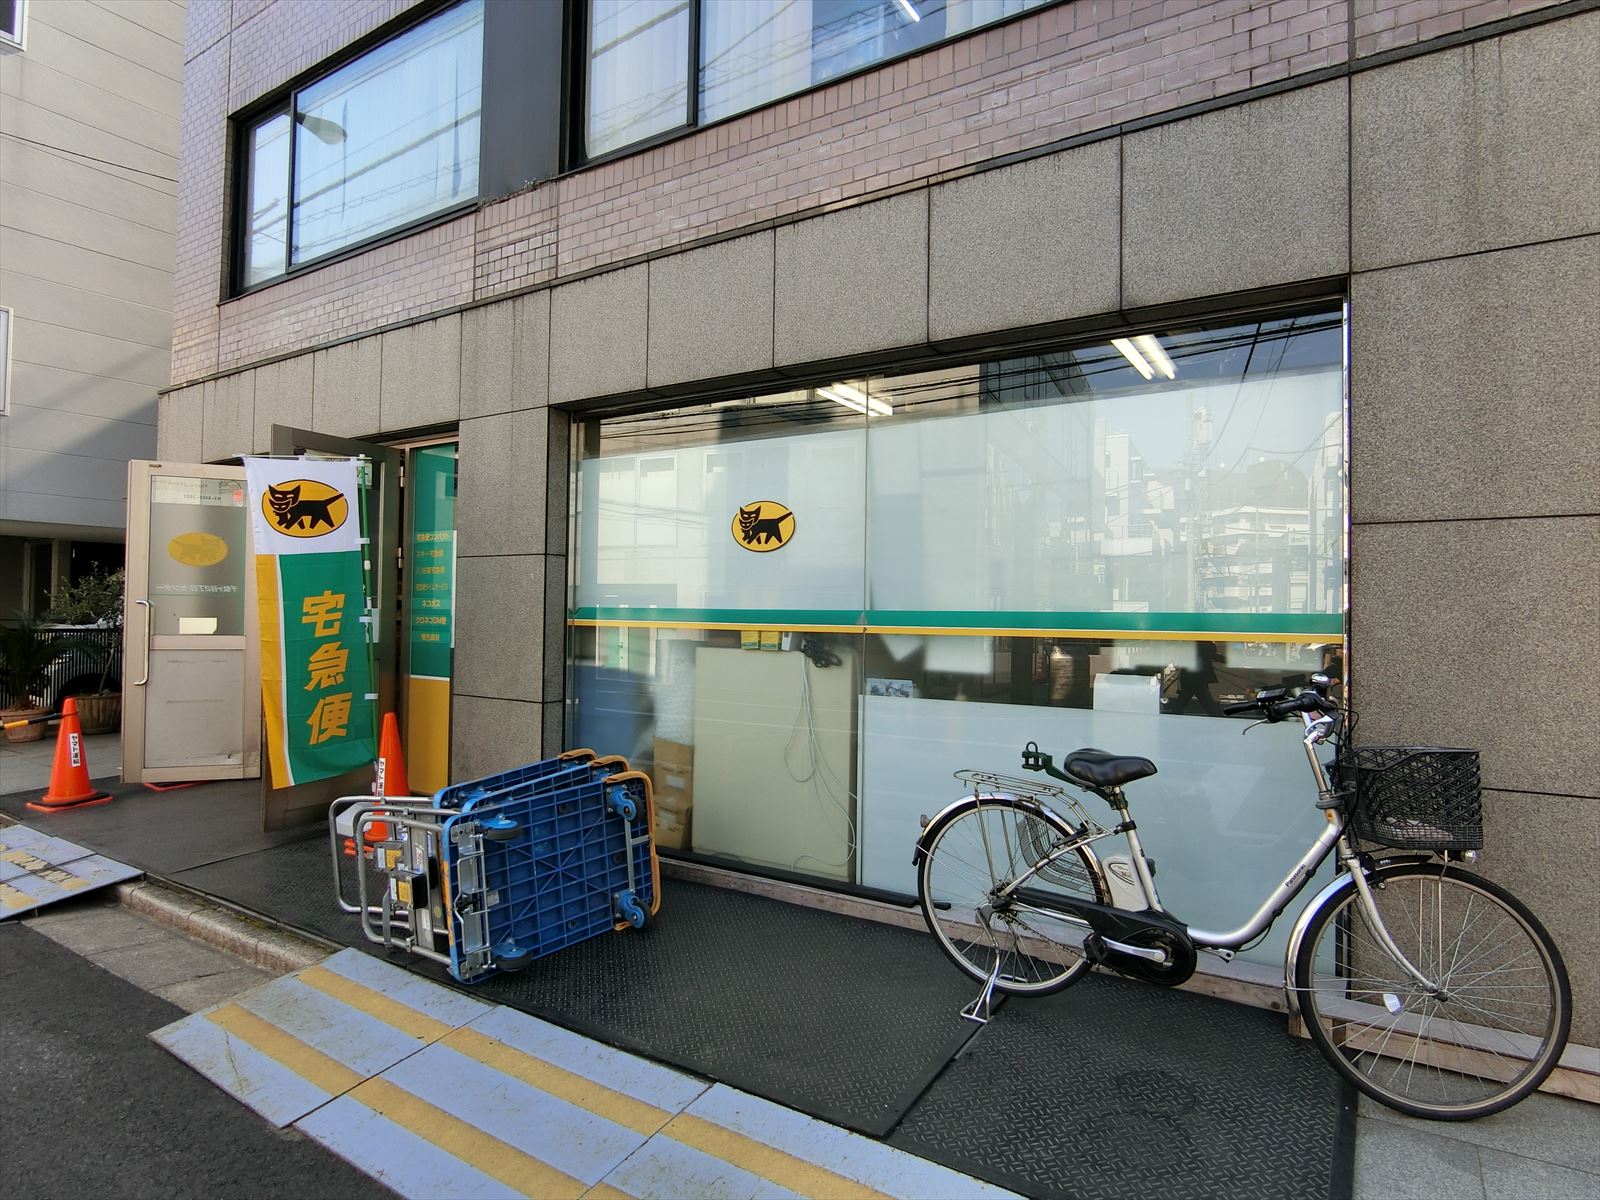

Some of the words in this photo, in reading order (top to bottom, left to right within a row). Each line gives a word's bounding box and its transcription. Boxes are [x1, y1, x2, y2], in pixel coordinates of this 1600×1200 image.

[302, 590, 353, 746] 宅急便
[1285, 863, 1306, 888] Panasonic
